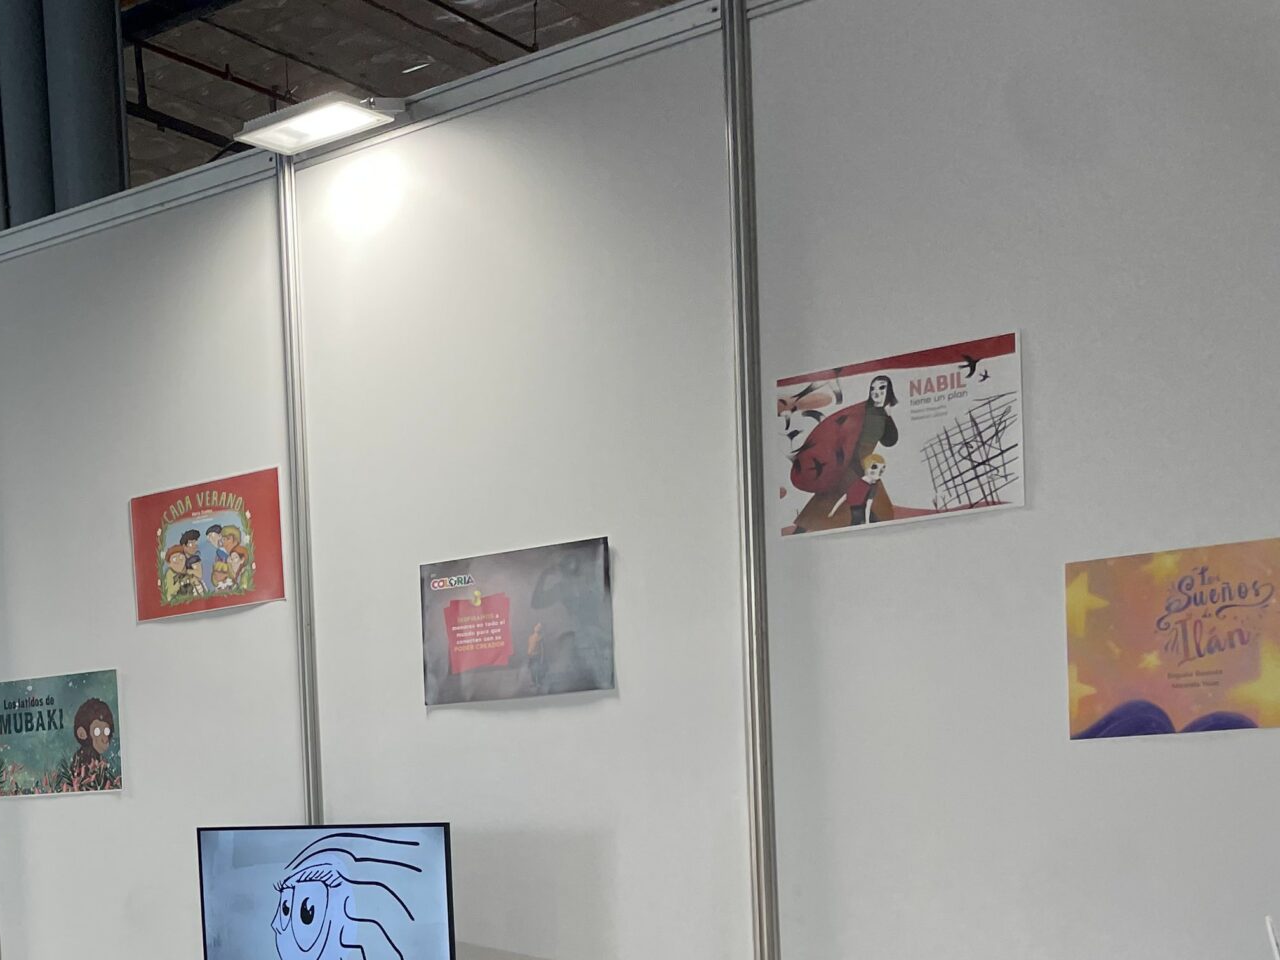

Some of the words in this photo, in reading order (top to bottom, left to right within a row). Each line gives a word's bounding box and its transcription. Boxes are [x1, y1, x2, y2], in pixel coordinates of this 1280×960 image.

[910, 371, 967, 397] NABIL
[934, 394, 945, 402] un
[948, 390, 968, 401] plan
[163, 495, 193, 524] CADA
[196, 490, 245, 512] VERANO
[431, 574, 474, 590] COLORIA
[1160, 575, 1273, 618] Sueños
[4, 699, 18, 710] Los
[18, 696, 44, 709] latidos
[46, 694, 54, 706] de
